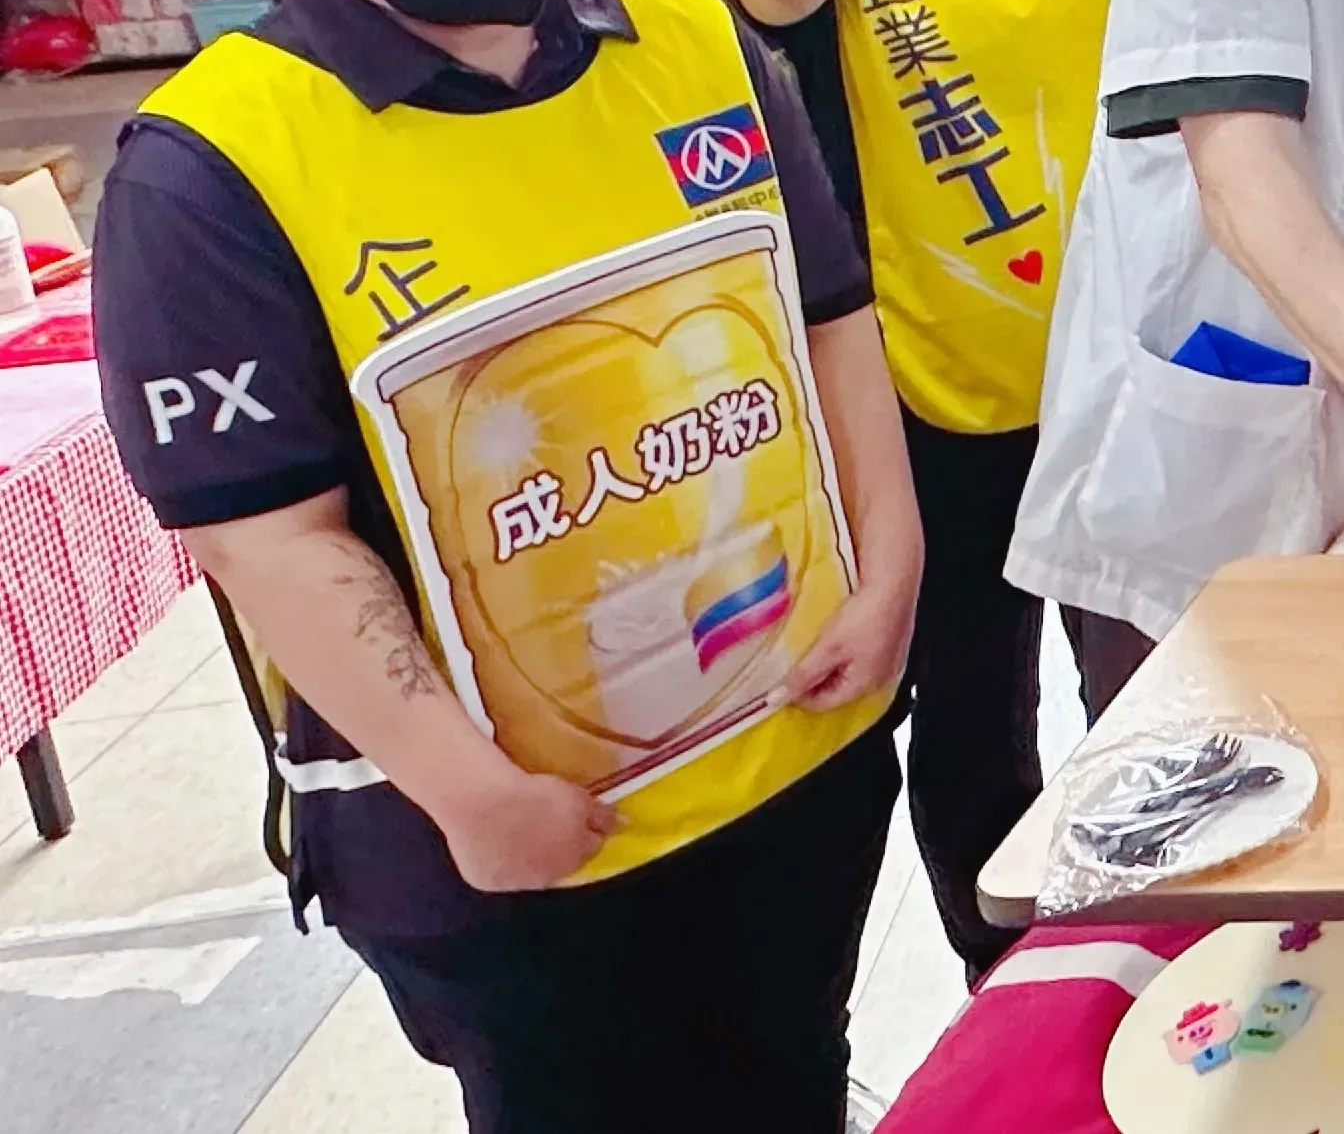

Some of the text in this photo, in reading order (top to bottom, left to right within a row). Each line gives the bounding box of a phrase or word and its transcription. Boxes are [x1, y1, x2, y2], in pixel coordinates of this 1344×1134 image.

[345, 238, 470, 342] 企
[146, 360, 276, 445] PX
[490, 378, 783, 565] 成人奶粉
